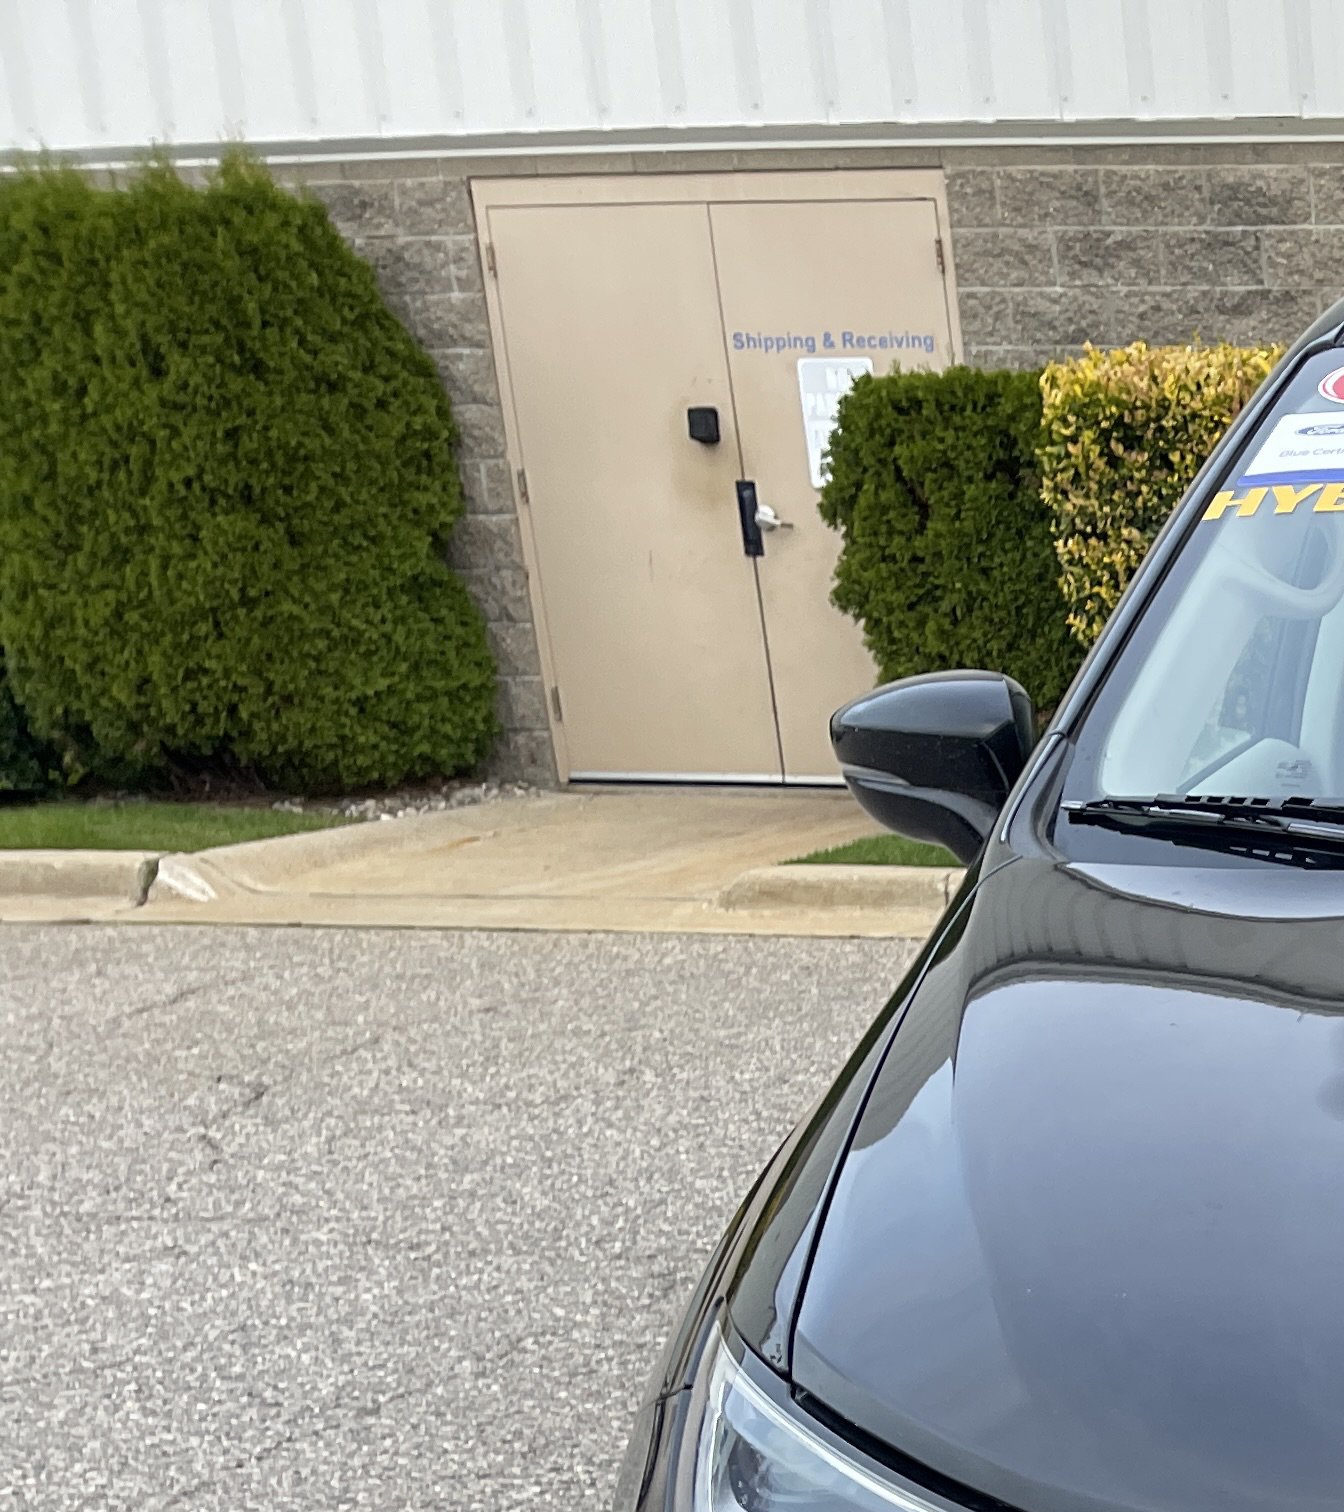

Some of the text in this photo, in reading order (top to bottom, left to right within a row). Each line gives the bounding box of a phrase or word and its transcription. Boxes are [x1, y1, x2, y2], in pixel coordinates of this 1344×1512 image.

[732, 331, 934, 353] Shipping & Receiving
